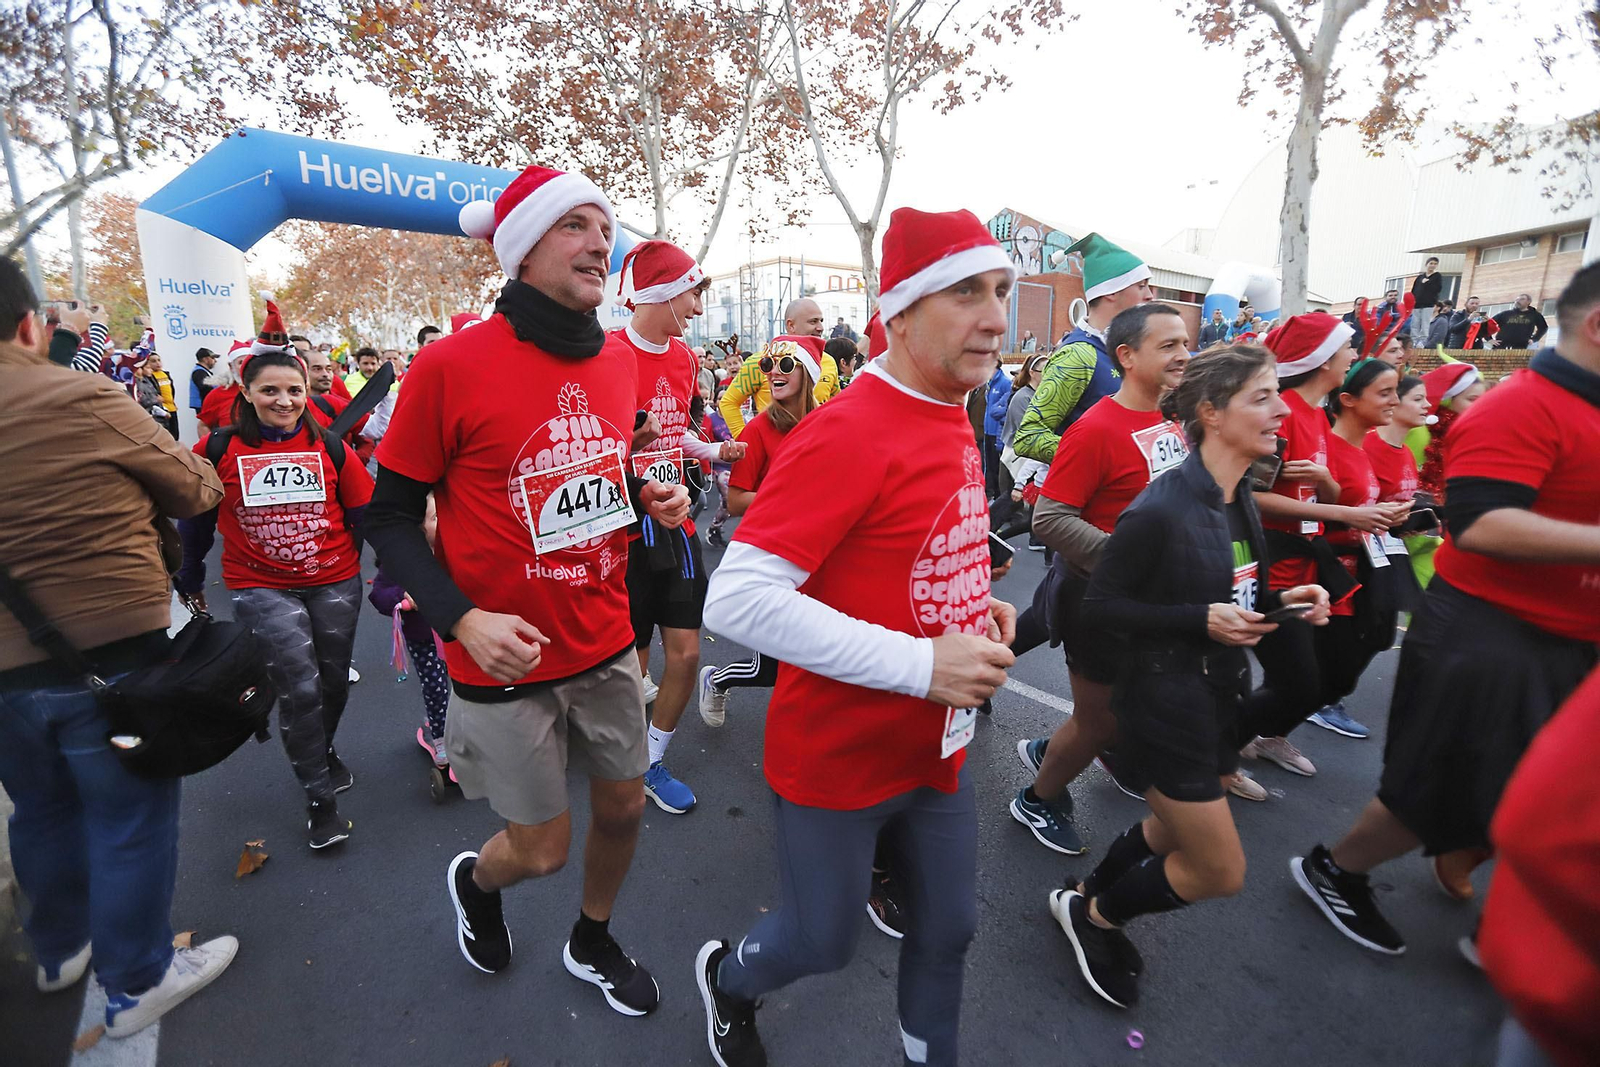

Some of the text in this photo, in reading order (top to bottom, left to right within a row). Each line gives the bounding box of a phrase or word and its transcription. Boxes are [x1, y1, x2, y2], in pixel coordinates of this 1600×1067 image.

[299, 150, 437, 201] Huelva
[159, 278, 230, 297] Huelva
[192, 328, 236, 337] HUELVA
[548, 415, 603, 443] XIII
[1156, 435, 1181, 462] 514
[263, 466, 304, 487] 473
[557, 477, 603, 518] 447
[264, 541, 319, 561] 2023
[525, 562, 588, 580] Huelva
[920, 603, 954, 626] 30
